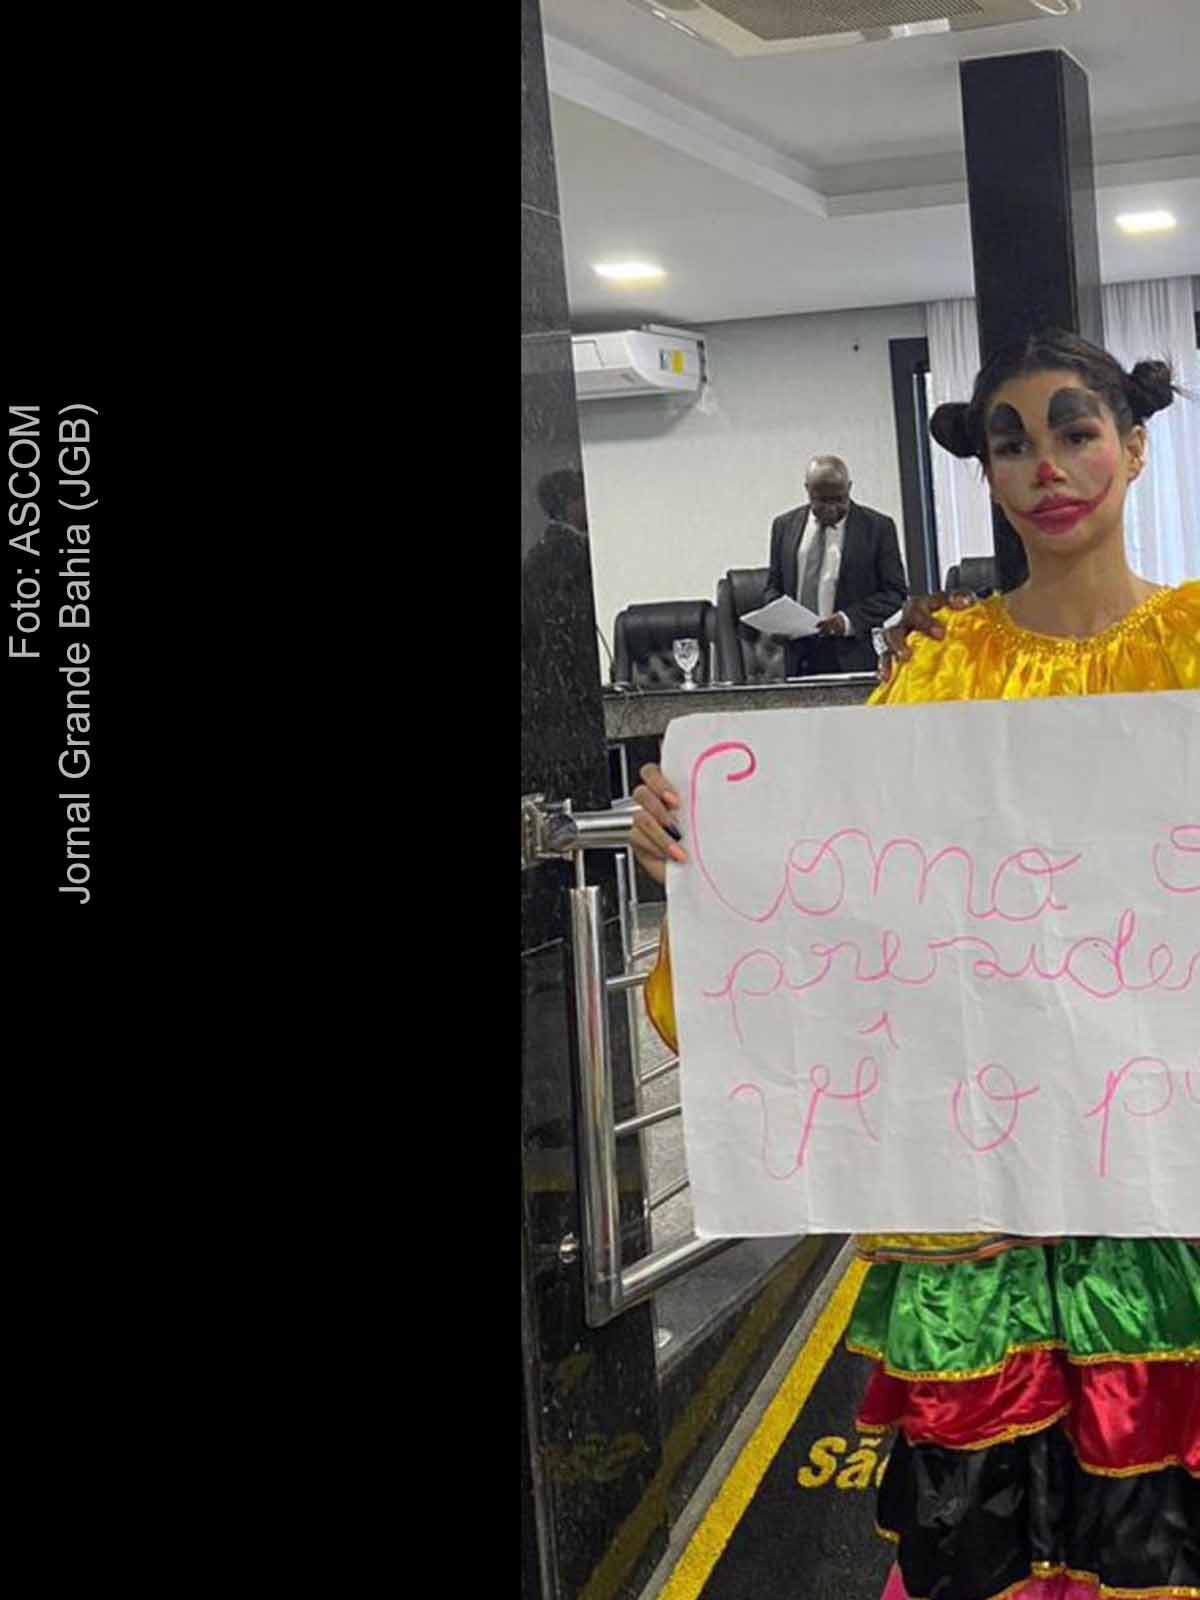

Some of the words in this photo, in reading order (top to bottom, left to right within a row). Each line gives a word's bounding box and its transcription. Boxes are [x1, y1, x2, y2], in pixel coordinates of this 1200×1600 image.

[689, 740, 1082, 924] Como
[951, 1064, 1042, 1154] o
[797, 1436, 891, 1489] Sã
